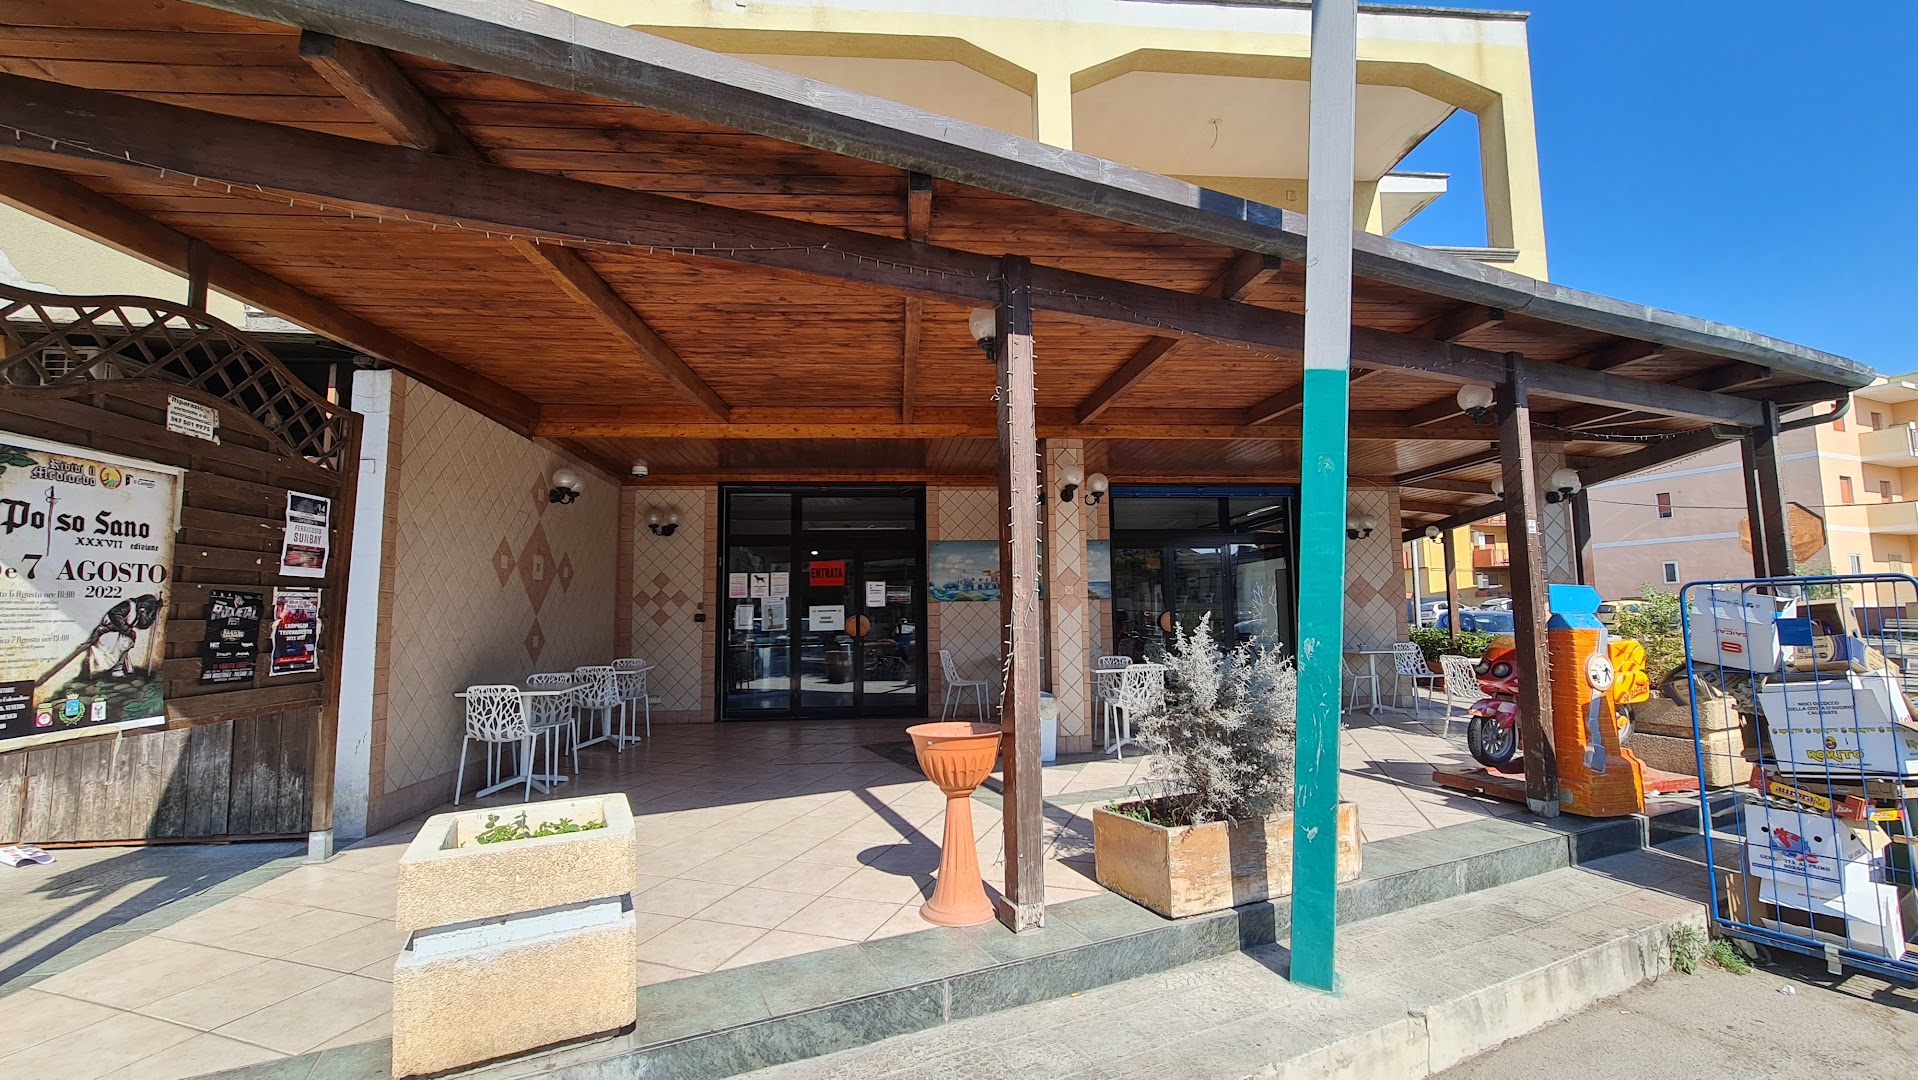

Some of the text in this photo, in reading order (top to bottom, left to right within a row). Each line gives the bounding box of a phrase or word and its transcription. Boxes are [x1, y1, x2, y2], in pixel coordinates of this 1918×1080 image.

[94, 510, 150, 539] Sano
[294, 524, 322, 535] FERRAGOSTO
[75, 536, 159, 552] XXXVII edizione
[293, 532, 322, 545] SUNBAY
[5, 566, 18, 579] e
[21, 554, 43, 580] 7
[56, 559, 167, 584] AGOSTO
[811, 567, 844, 579] ENTRATA
[85, 585, 122, 599] 2022
[1806, 749, 1864, 763] KOKITO
[1775, 785, 1813, 803] aurora
[1808, 865, 1831, 873] PRIMO
